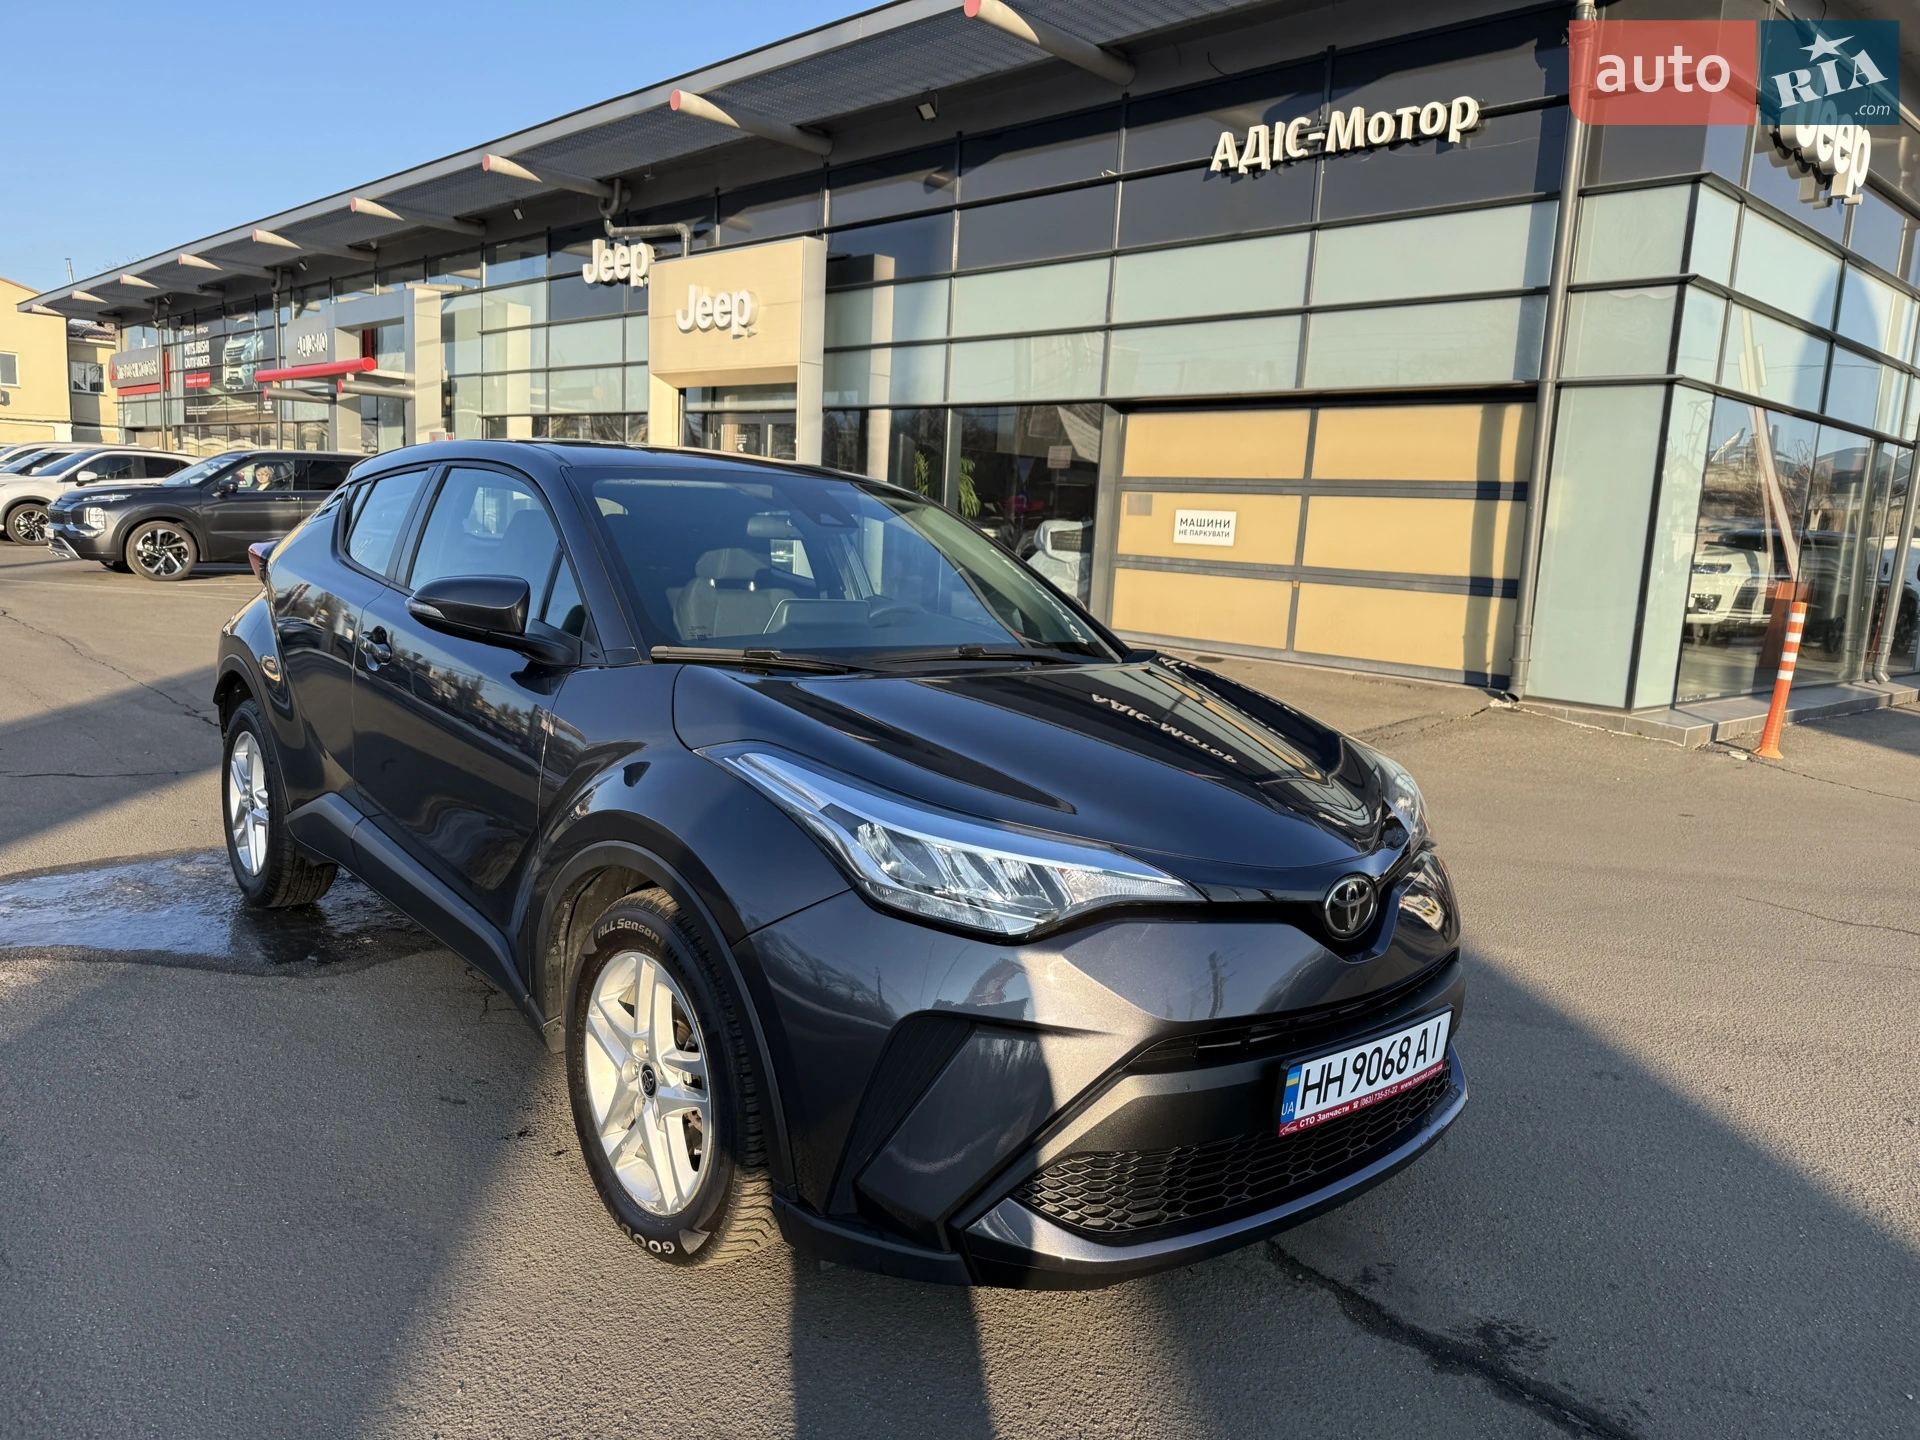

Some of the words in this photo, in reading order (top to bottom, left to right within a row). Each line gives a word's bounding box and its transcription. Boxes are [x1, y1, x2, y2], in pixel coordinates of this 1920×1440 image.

[1210, 95, 1480, 174] АДІС-Мотор
[583, 239, 655, 287] Jeep
[676, 284, 758, 339] Jeep
[1179, 517, 1231, 529] МАШИНИ
[1189, 529, 1230, 538] ПАРКУВАТИ
[597, 920, 616, 939] ALL
[617, 918, 660, 944] Season
[1281, 1101, 1294, 1116] UA
[1299, 1116, 1316, 1128] СТО
[1316, 1105, 1350, 1122] Запчасти
